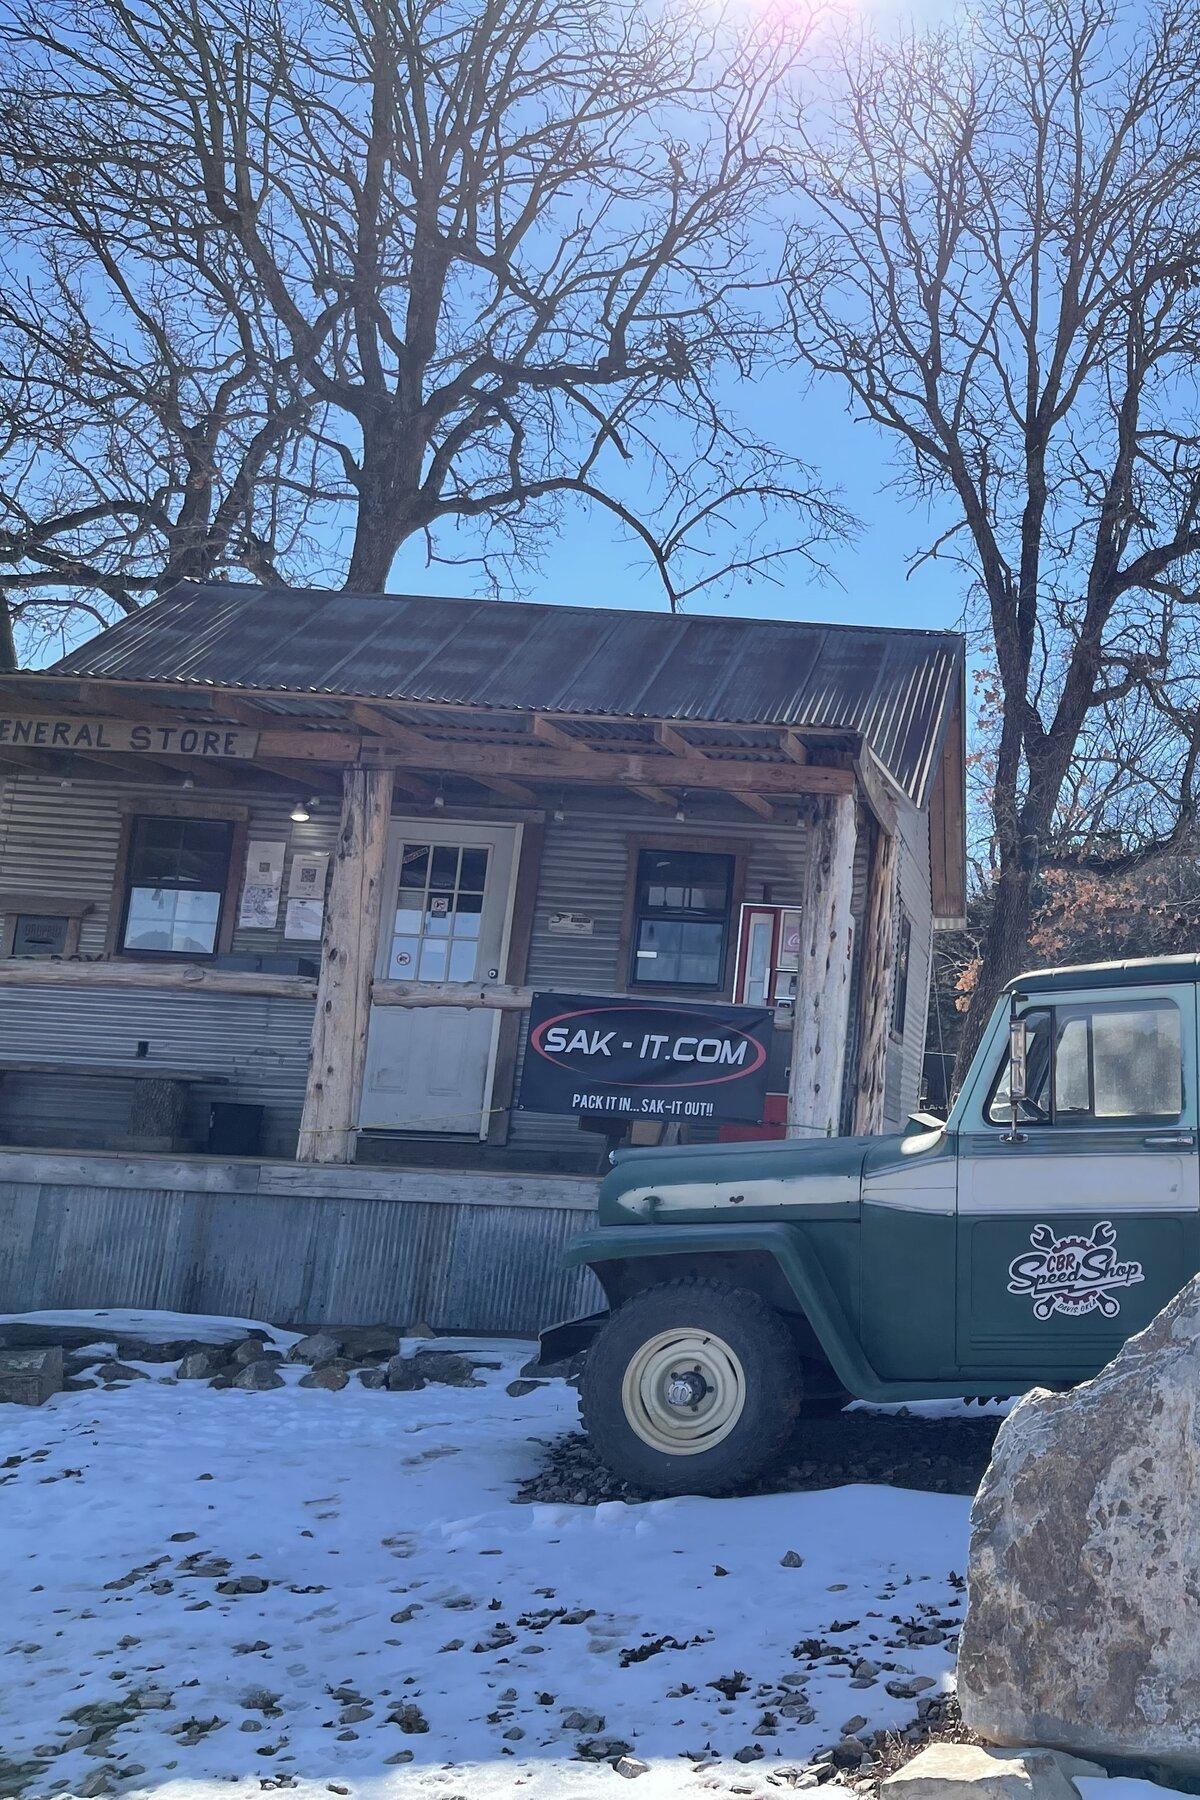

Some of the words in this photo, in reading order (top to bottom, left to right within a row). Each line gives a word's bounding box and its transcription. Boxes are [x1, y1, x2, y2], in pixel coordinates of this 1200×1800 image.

[129, 725, 239, 755] STORE
[545, 1028, 617, 1055] SAK
[639, 1034, 748, 1065] IT.COM
[572, 1094, 603, 1110] PACK
[606, 1096, 616, 1110] IT
[642, 1099, 682, 1114] SAK-IT
[684, 1101, 713, 1116] OUT!!
[1009, 1255, 1081, 1291] Speed
[1080, 1247, 1139, 1283] Shop
[1046, 1253, 1076, 1273] CBR
